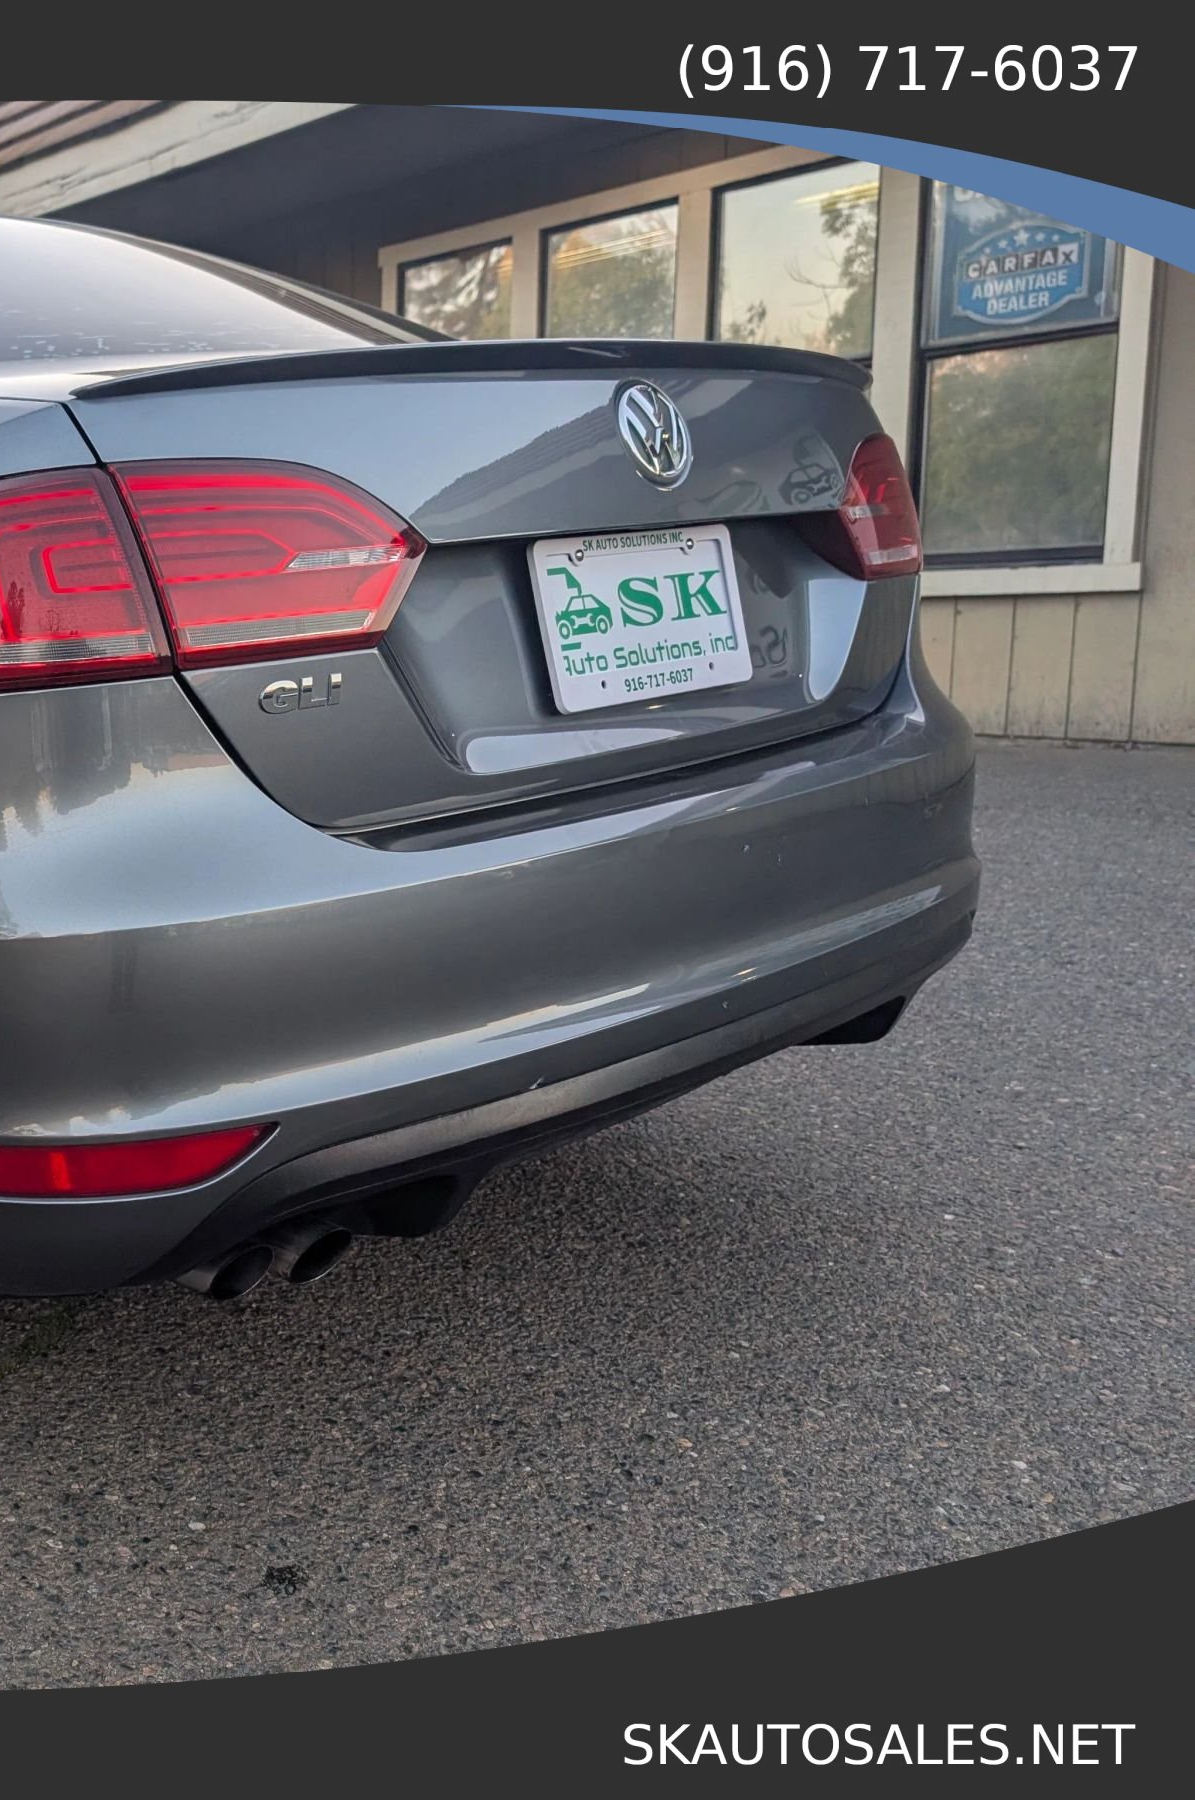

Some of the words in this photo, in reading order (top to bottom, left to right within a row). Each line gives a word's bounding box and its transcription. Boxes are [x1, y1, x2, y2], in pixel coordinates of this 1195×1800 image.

[966, 244, 1079, 279] CARFAX
[971, 269, 1068, 300] ADVANTAGE
[986, 291, 1050, 315] DEALER
[582, 539, 597, 552] SK
[596, 537, 619, 551] AUTO
[620, 533, 668, 548] SOLUTIONS
[669, 531, 684, 543] INC
[616, 569, 727, 628] SK
[709, 632, 737, 654] inc
[258, 672, 342, 714] GLI
[624, 668, 694, 693] 916-717-6037
